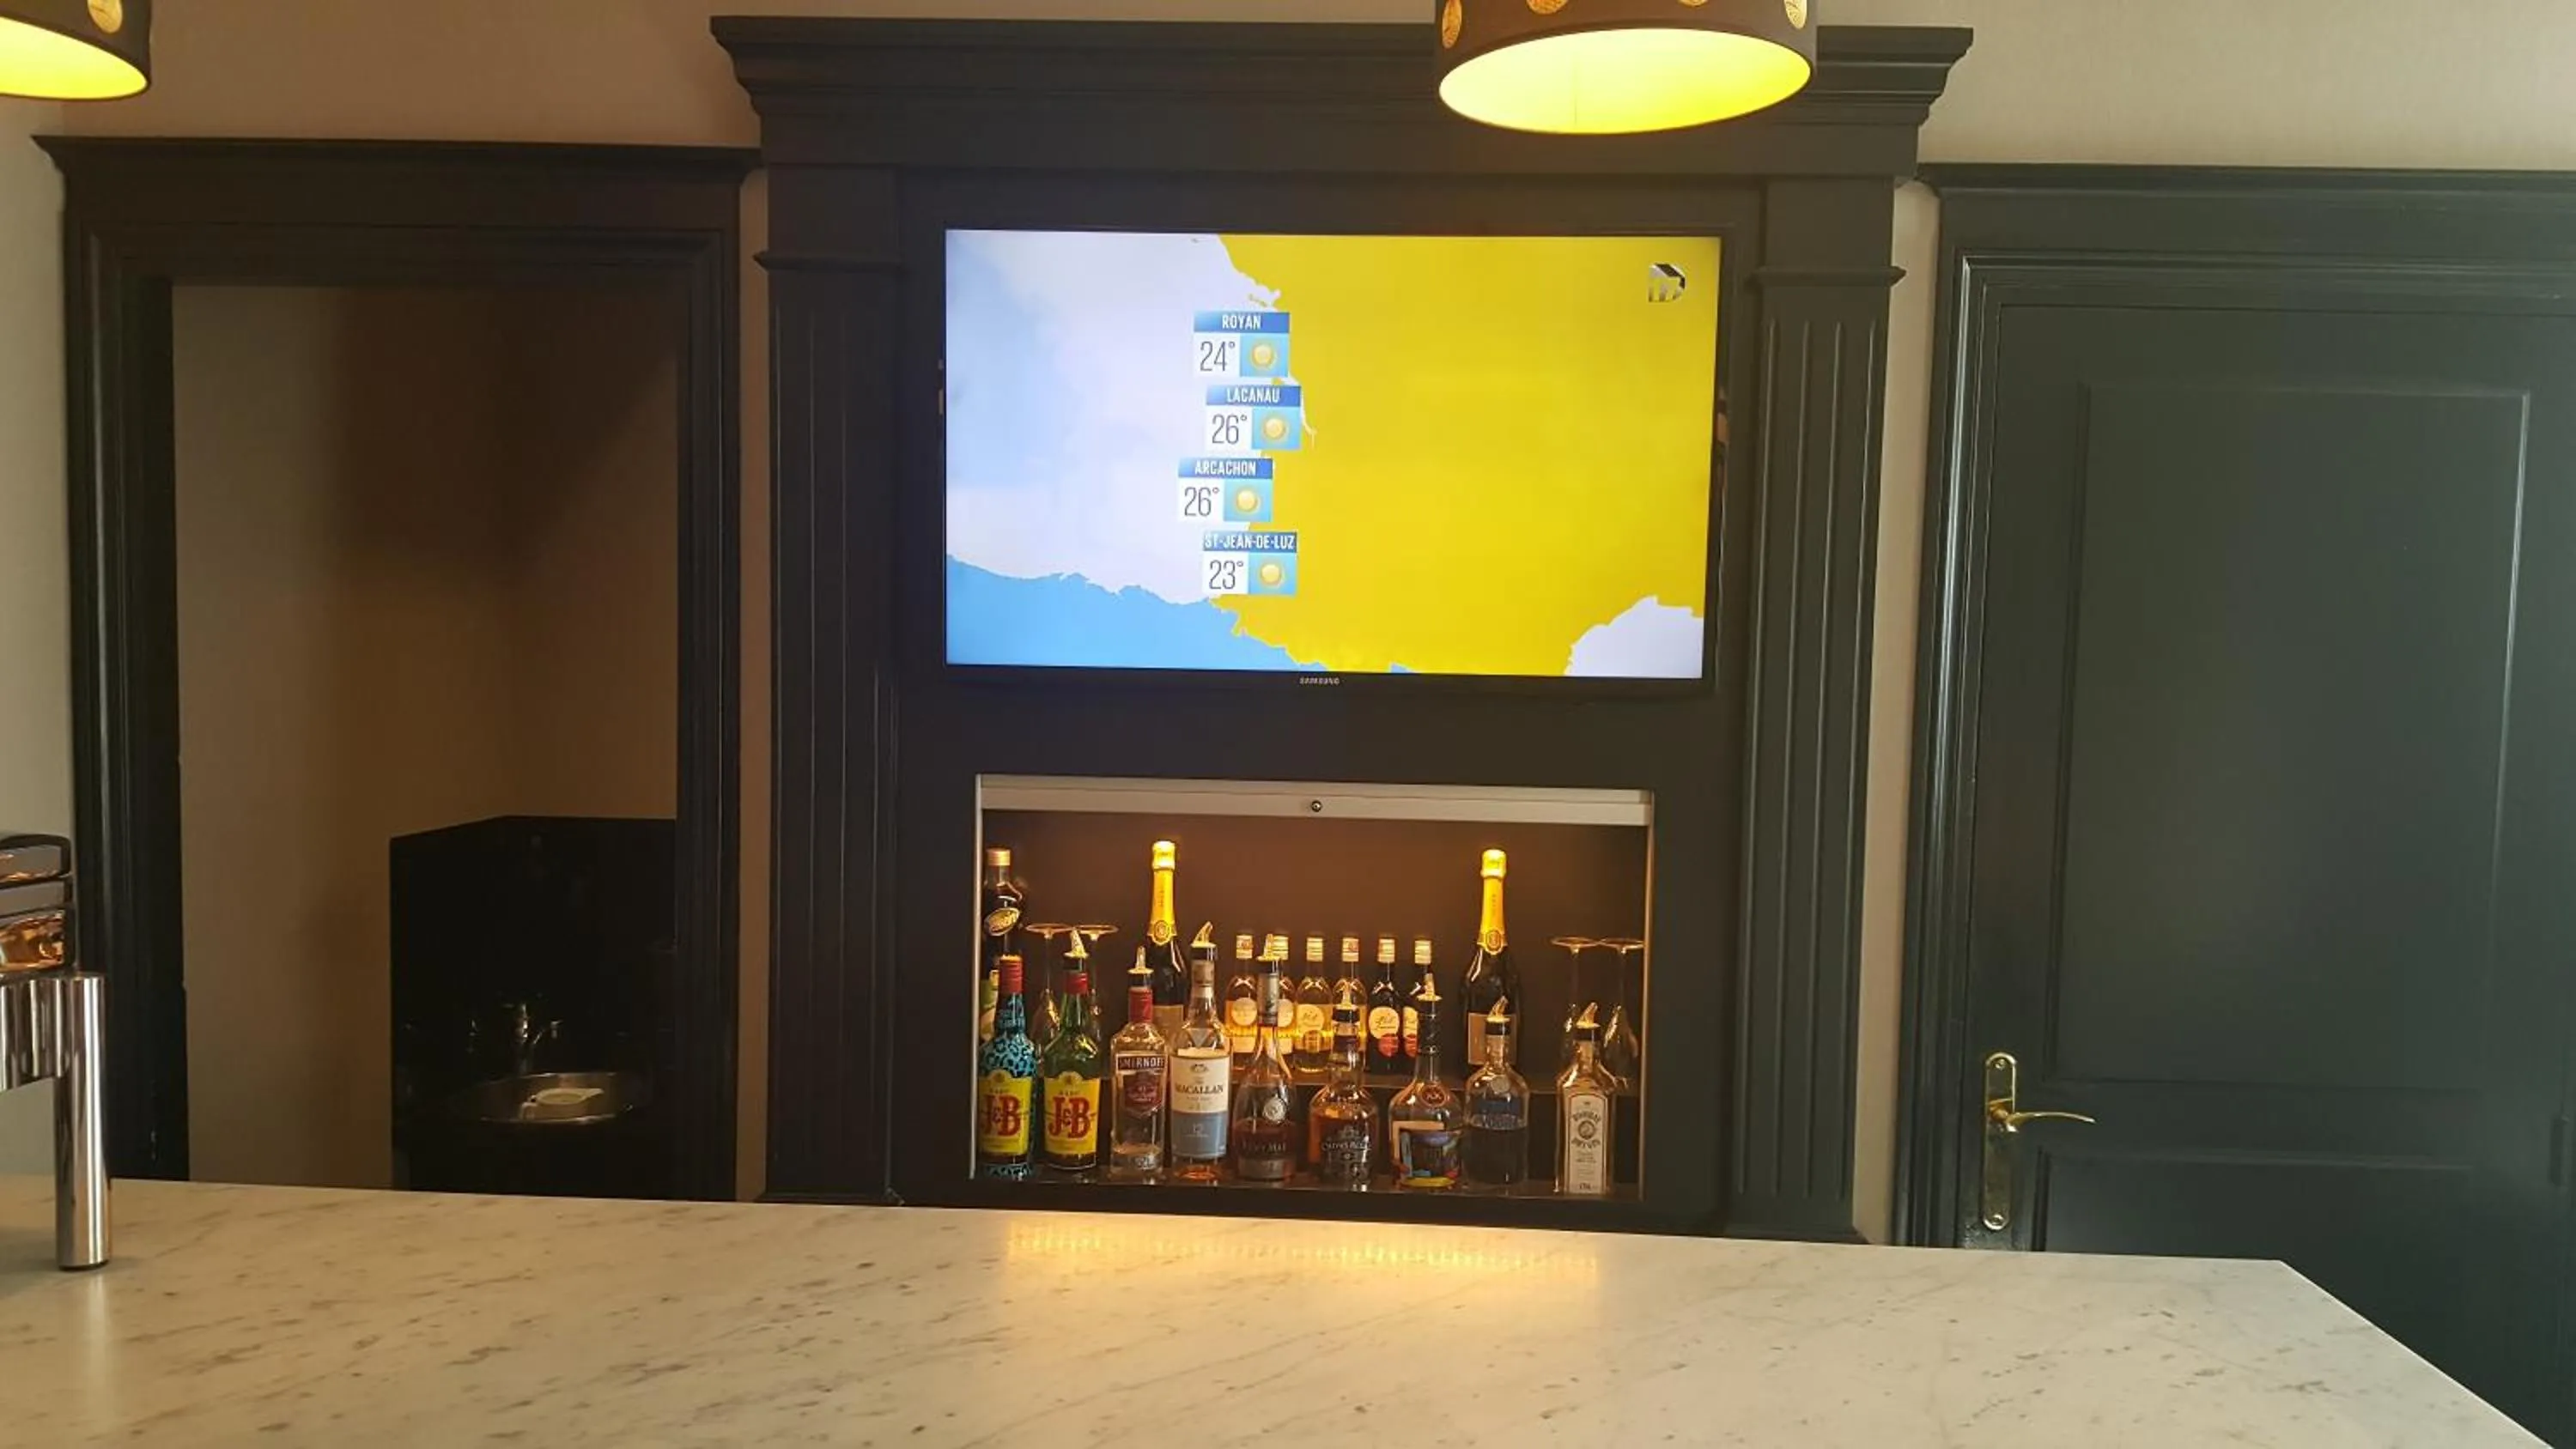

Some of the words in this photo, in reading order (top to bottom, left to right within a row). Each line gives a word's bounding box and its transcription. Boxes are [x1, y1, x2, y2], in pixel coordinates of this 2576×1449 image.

[1222, 314, 1261, 330] ROYAN
[1200, 341, 1236, 372] 24°
[1226, 387, 1281, 403] LACANAU
[1212, 414, 1248, 445] 26°
[1194, 460, 1257, 476] ARCACHON
[1184, 487, 1219, 517] 26°
[1205, 534, 1296, 550] ST-JEAN-DE-LUZ
[1209, 560, 1244, 590] 23°
[1119, 1057, 1165, 1070] SMIRNOFF
[1175, 1084, 1224, 1094] MACALLAN
[1048, 1096, 1091, 1139] J&B
